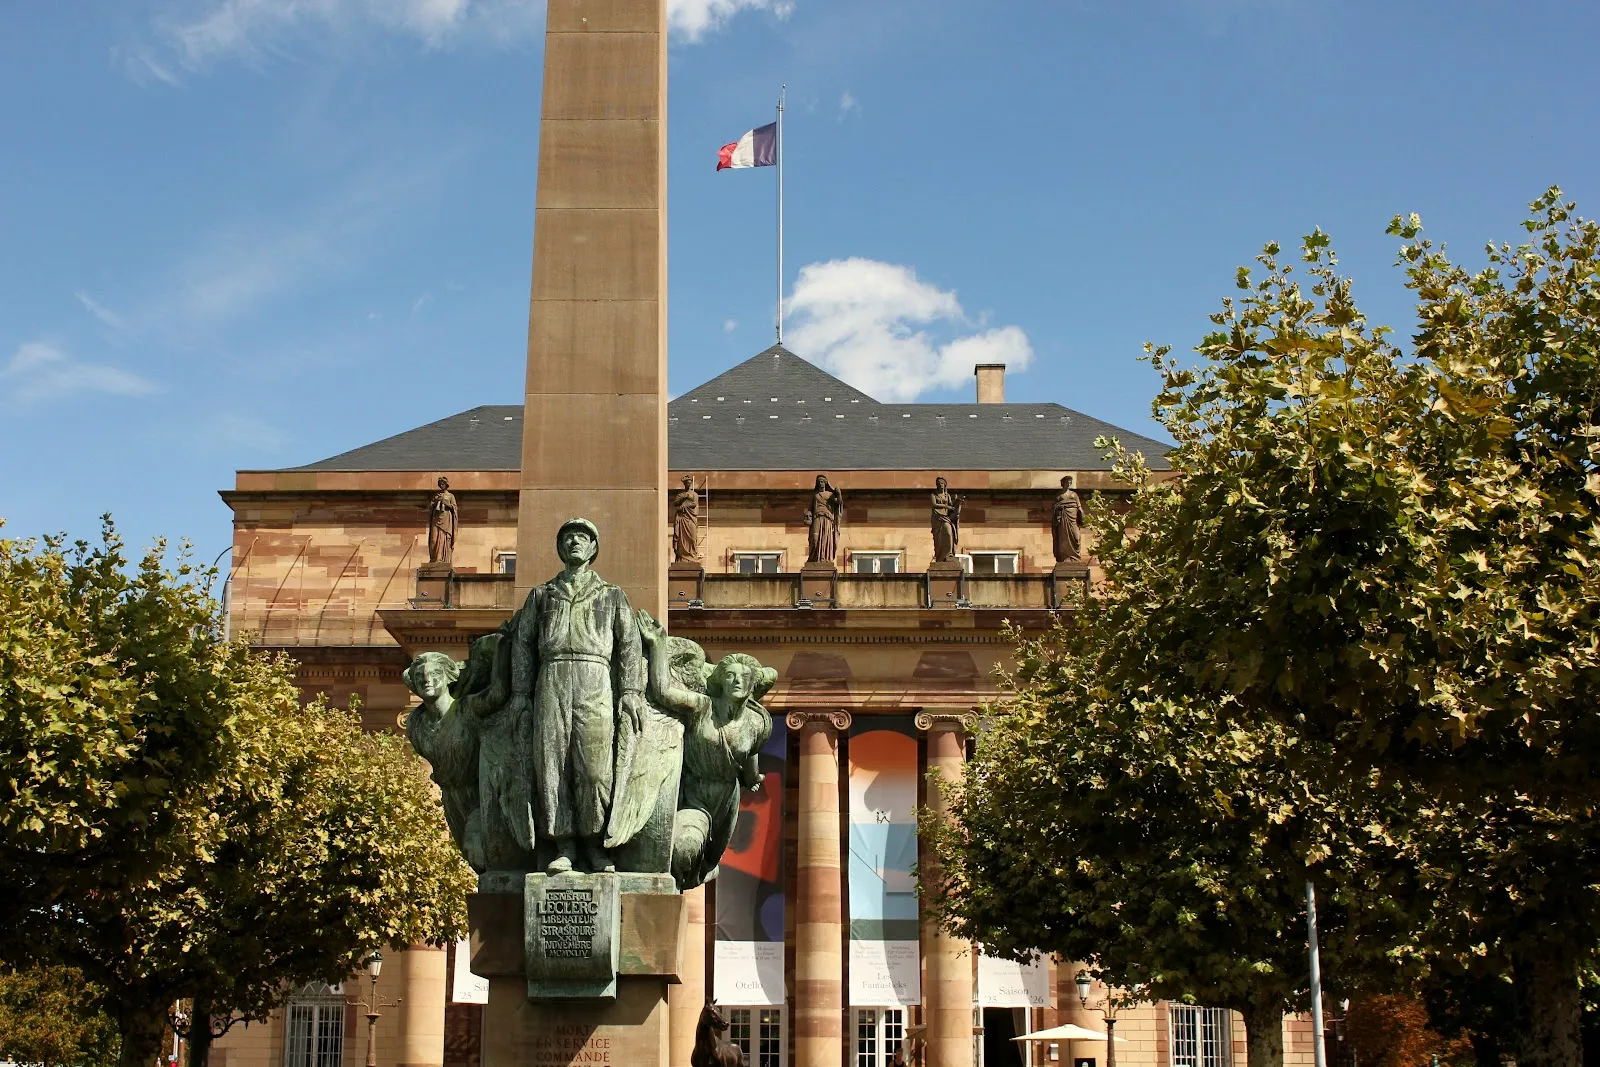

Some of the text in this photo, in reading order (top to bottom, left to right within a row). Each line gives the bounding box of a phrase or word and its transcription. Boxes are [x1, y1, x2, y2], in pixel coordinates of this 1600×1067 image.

[539, 901, 599, 914] LECLERC
[541, 925, 596, 937] STRASBOURG
[545, 940, 592, 949] NOVEMBRE
[877, 972, 892, 980] Les
[735, 980, 764, 990] Otello
[998, 986, 1029, 995] Saison
[556, 1025, 592, 1036] MORT
